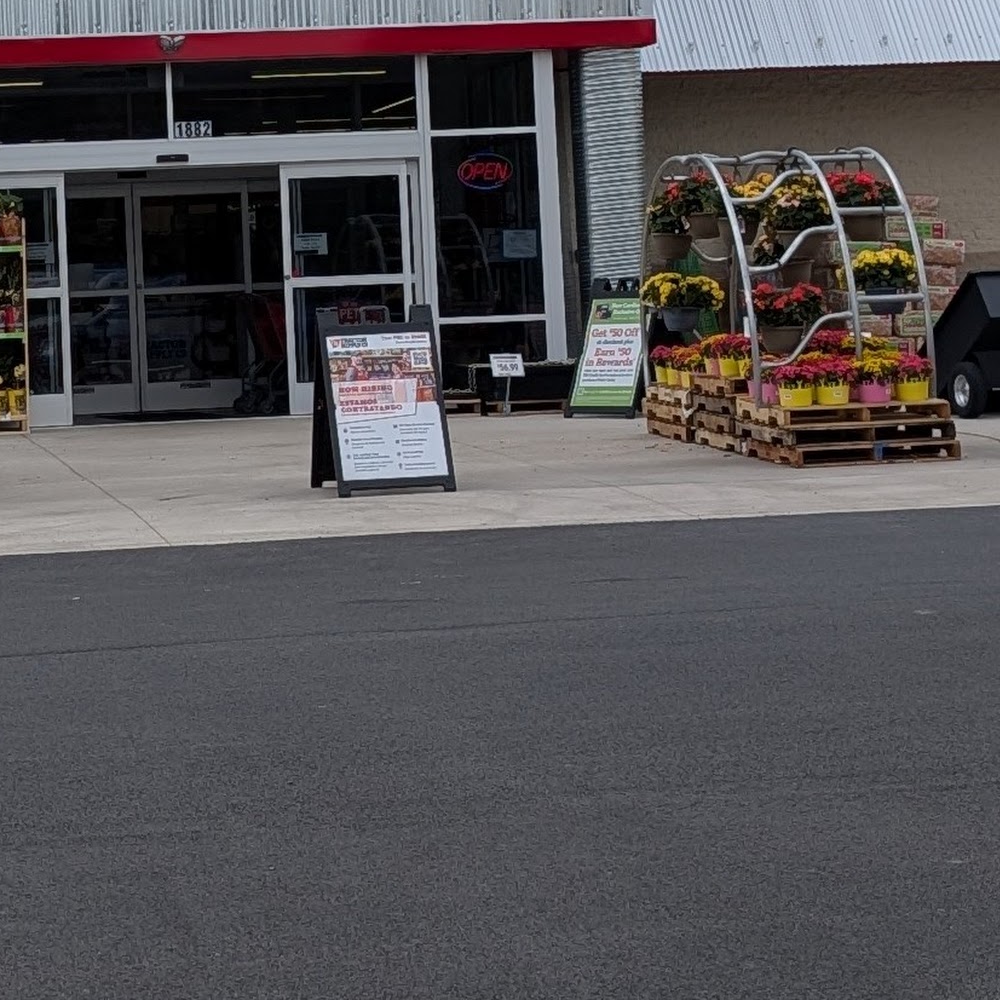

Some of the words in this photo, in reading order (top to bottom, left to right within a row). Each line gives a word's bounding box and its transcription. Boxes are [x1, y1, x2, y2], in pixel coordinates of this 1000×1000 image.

[177, 120, 211, 137] 1882
[460, 162, 508, 180] OPEN
[591, 328, 607, 338] Get
[624, 327, 640, 338] Off
[594, 348, 615, 357] Earn
[585, 358, 594, 366] in
[596, 357, 633, 366] Rewards
[339, 398, 378, 407] ESTAMOS
[341, 404, 403, 414] CONTRATANDO
